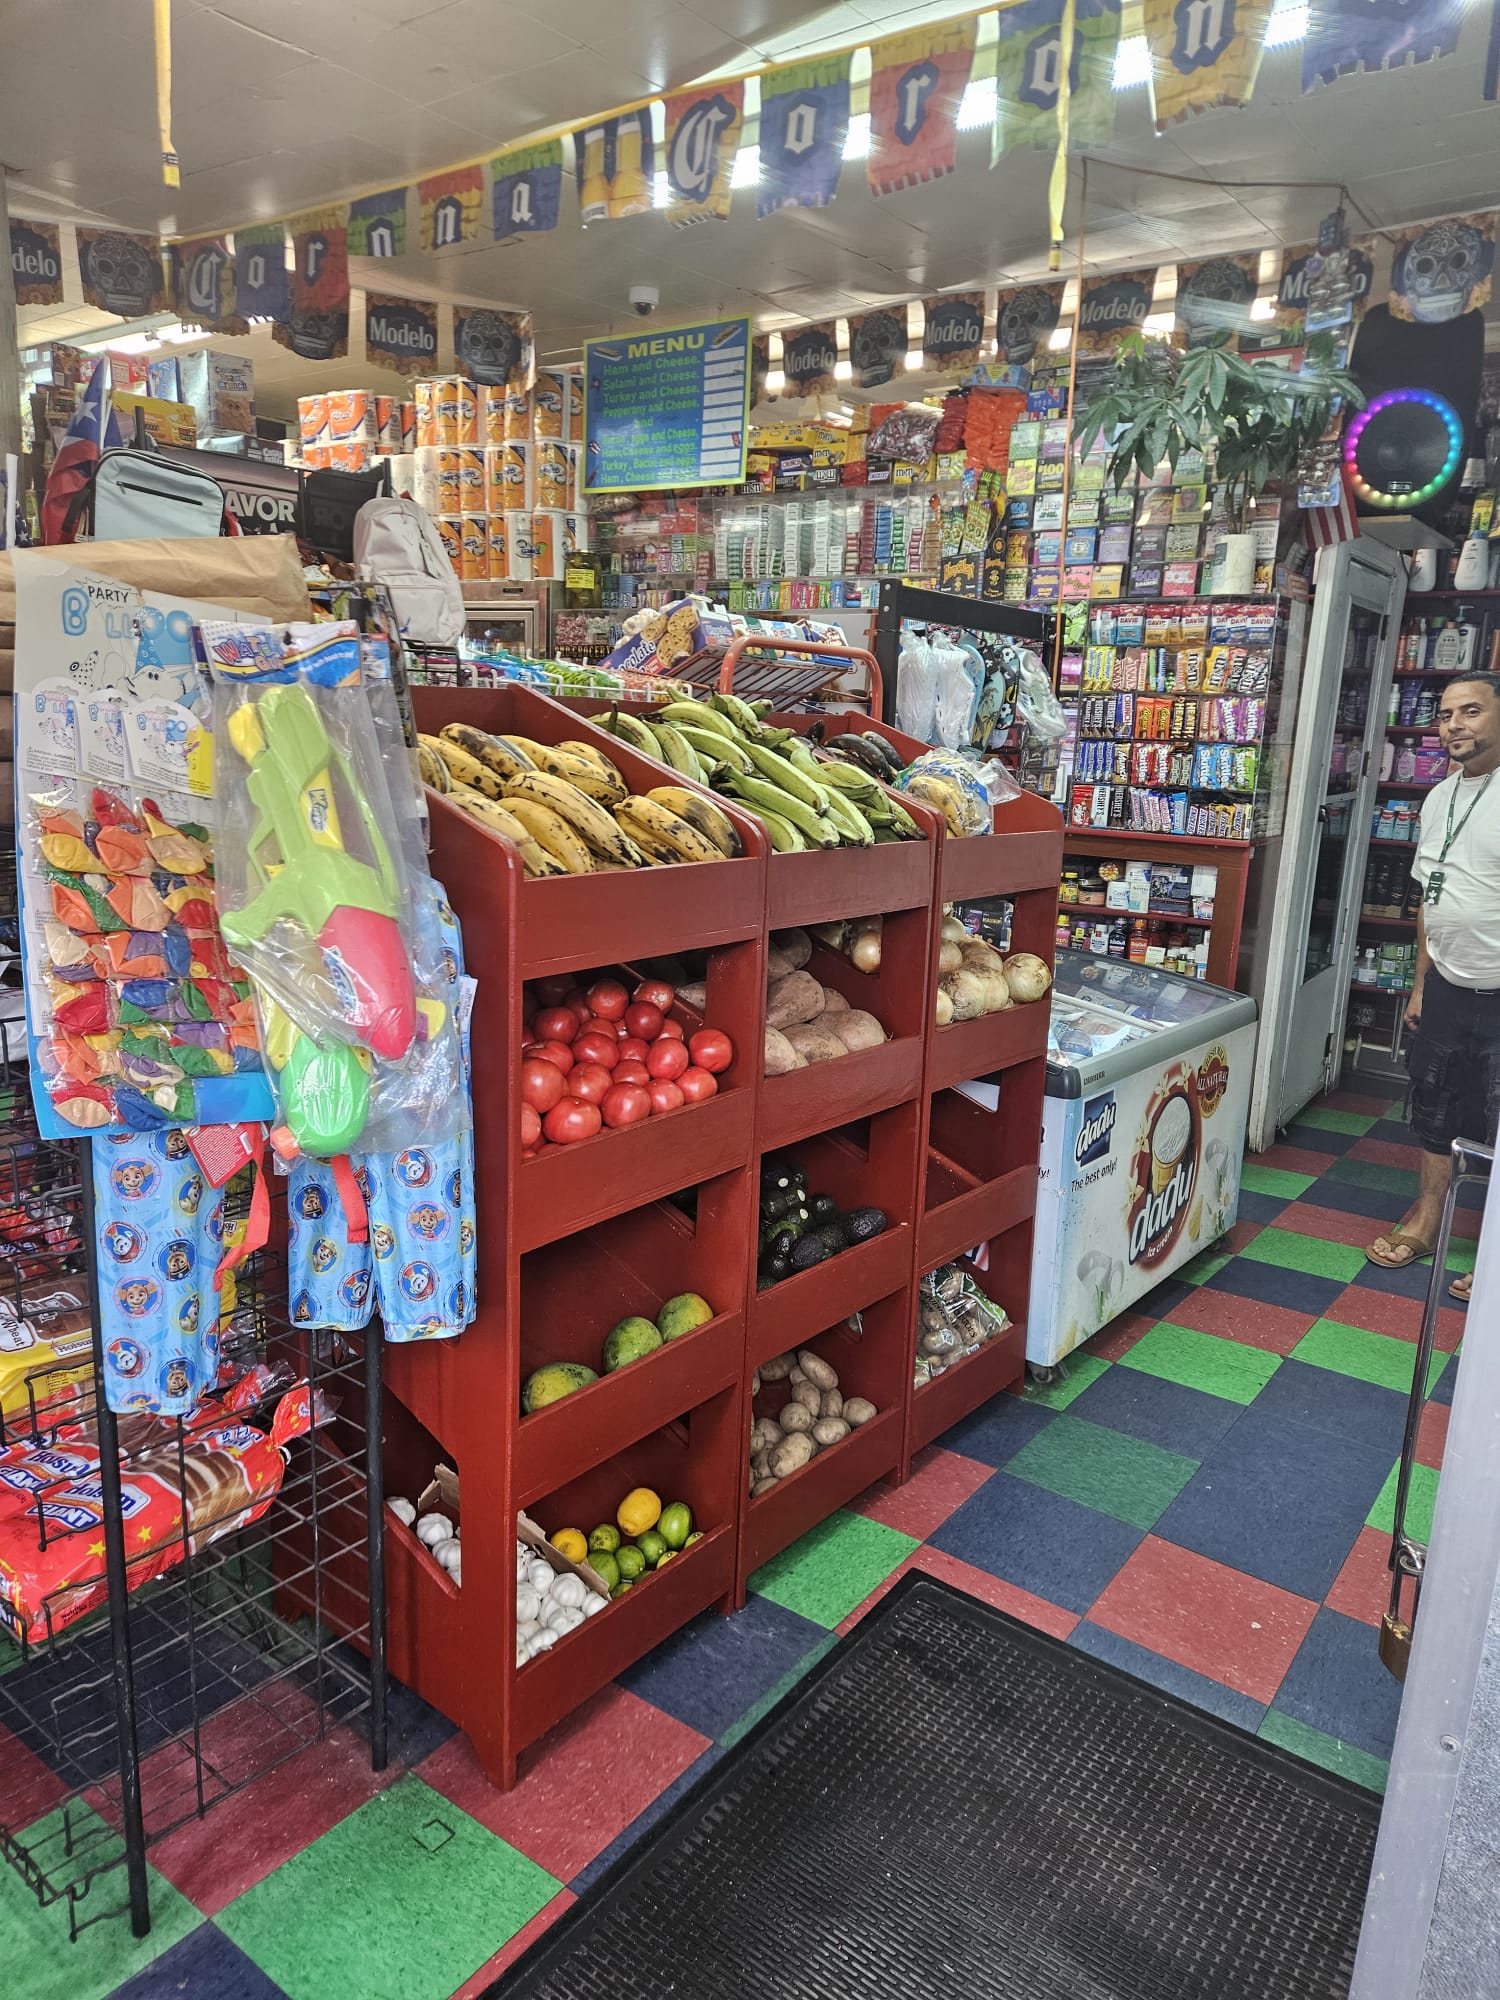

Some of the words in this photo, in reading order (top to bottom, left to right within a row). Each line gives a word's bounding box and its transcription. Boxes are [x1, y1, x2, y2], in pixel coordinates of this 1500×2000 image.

[12, 250, 57, 278] delo
[1081, 296, 1147, 325] Modelo
[369, 315, 435, 351] Modelo
[628, 333, 705, 359] MENU
[925, 318, 980, 346] Modelo
[603, 364, 629, 377] Ham
[632, 359, 650, 372] and
[784, 346, 834, 375] Modelo
[638, 374, 657, 386] and
[603, 391, 637, 404] Turkey
[639, 387, 657, 399] and
[633, 416, 654, 428] and
[224, 489, 296, 523] AVOR
[87, 584, 129, 604] PARTY
[1119, 616, 1139, 625] DAVID
[1184, 616, 1205, 625] DAVID
[1250, 617, 1271, 626] DAVID
[1122, 694, 1133, 726] CRUNCH
[1172, 701, 1184, 735] HEATH
[1185, 701, 1197, 734] HEATH
[1221, 698, 1237, 741] Skittles
[1247, 699, 1258, 740] Skittles
[1137, 746, 1149, 785] Skittles
[1156, 745, 1168, 785] Skittles
[1200, 748, 1211, 789] Skittles
[1219, 747, 1231, 790] Skittles
[1096, 787, 1105, 816] HERSHEY'S
[1114, 786, 1124, 818] HERSHEY'S
[1077, 1103, 1116, 1158] dadu
[1071, 1176, 1084, 1193] The
[1084, 1169, 1101, 1187] best
[1101, 1157, 1118, 1180] only!
[1131, 1161, 1194, 1264] dadu
[1155, 1226, 1173, 1253] cream
[57, 1339, 93, 1353] Holsu
[28, 1503, 97, 1528] GIANT
